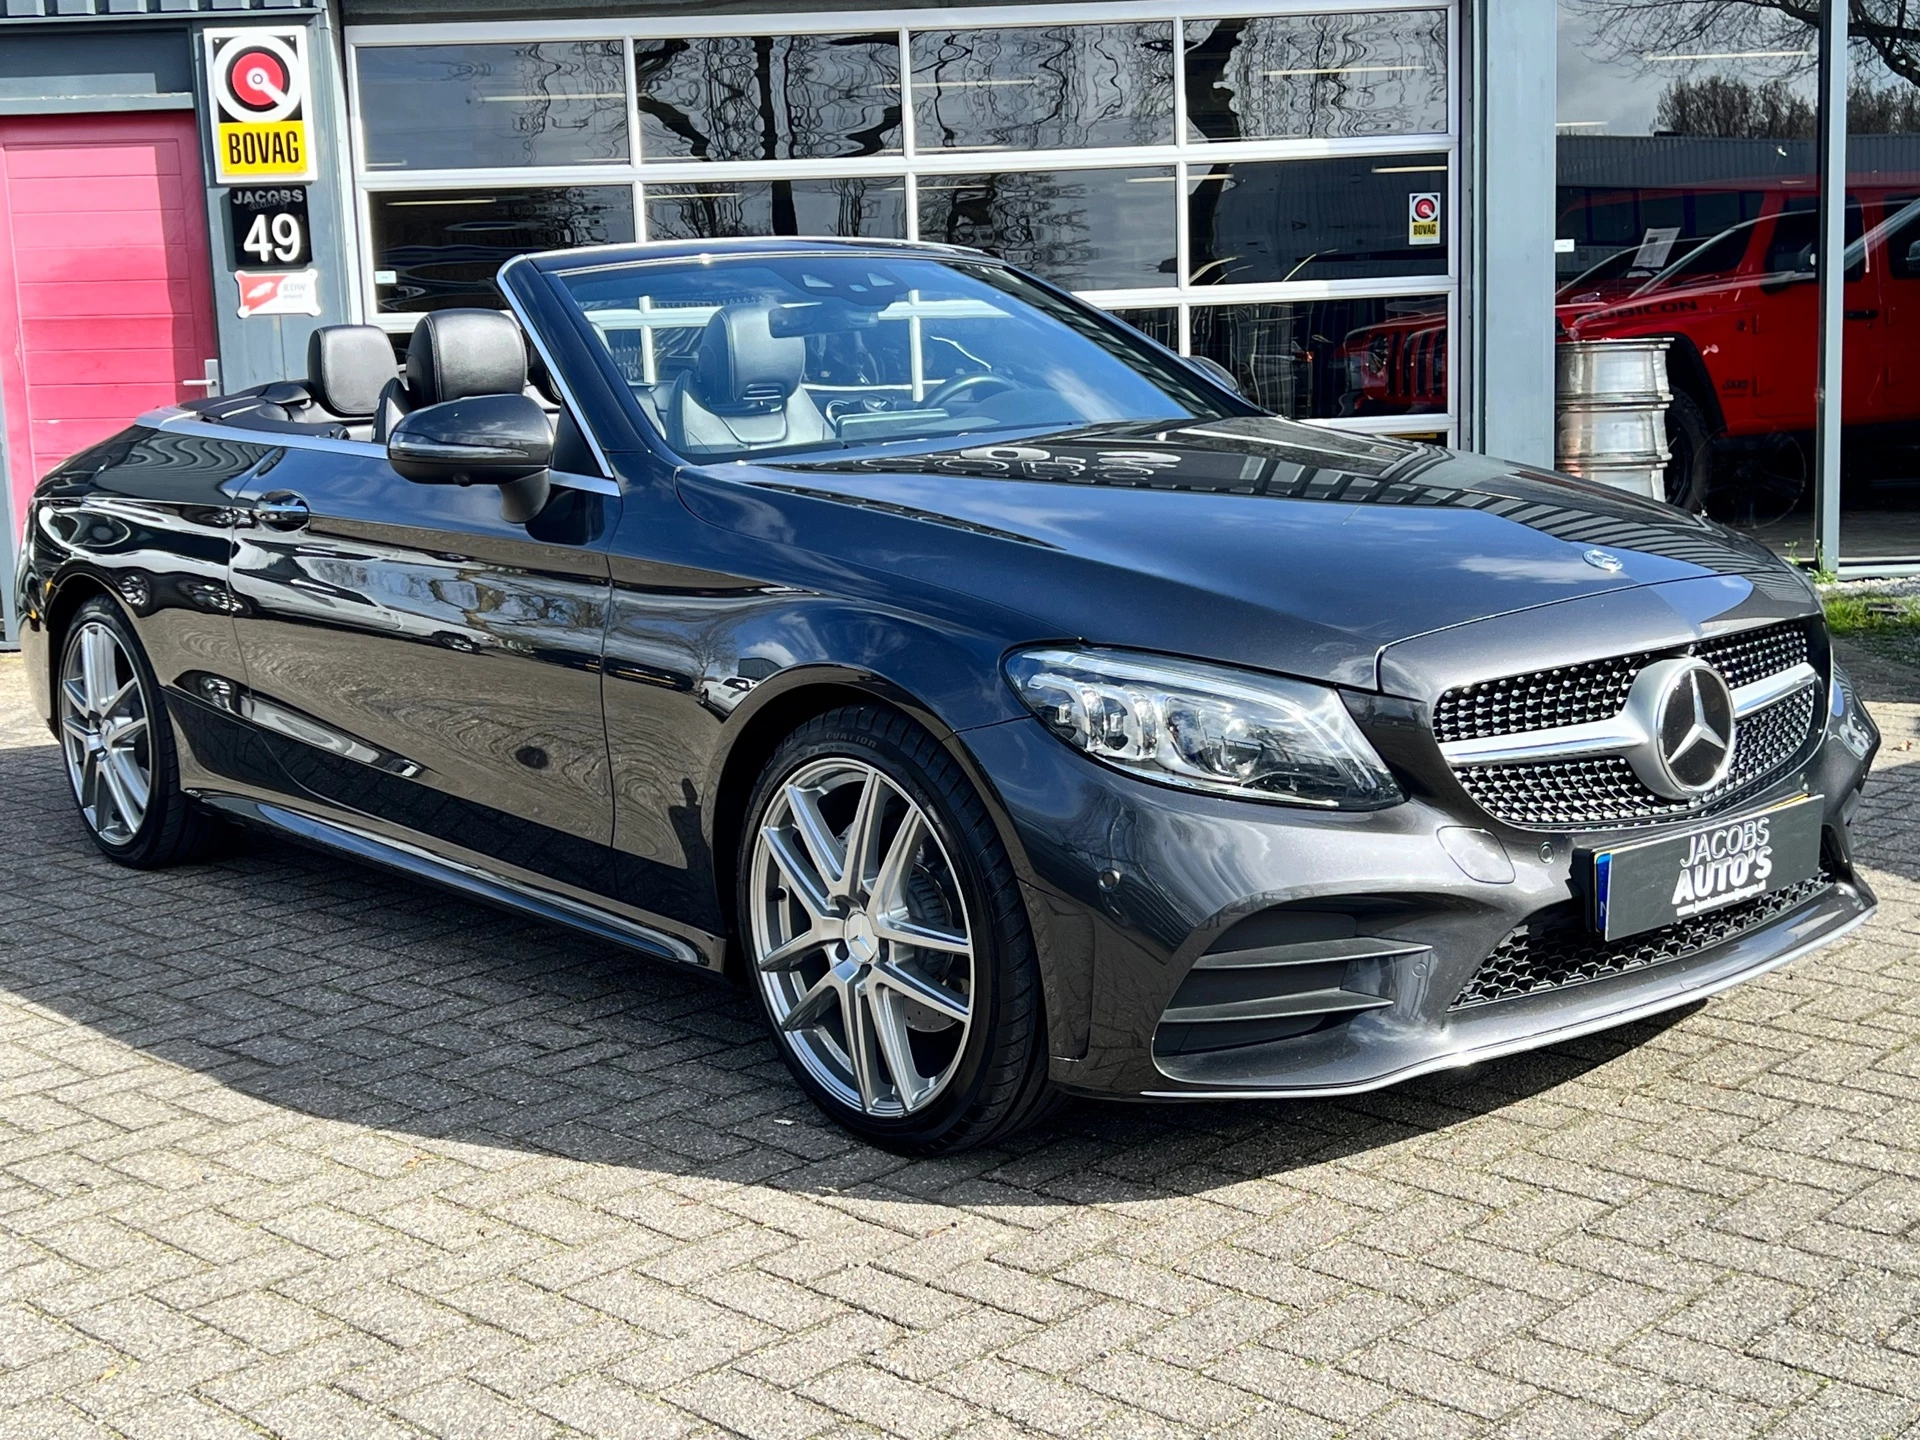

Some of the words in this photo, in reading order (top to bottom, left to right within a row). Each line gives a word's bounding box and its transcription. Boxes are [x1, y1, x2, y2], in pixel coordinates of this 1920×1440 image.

[228, 130, 299, 165] BOVAG
[232, 188, 304, 205] JACOBS
[243, 213, 301, 262] 49
[1413, 223, 1437, 235] BOVAG
[1680, 816, 1771, 868] JACOBS
[1672, 845, 1773, 905] AUTO'S
